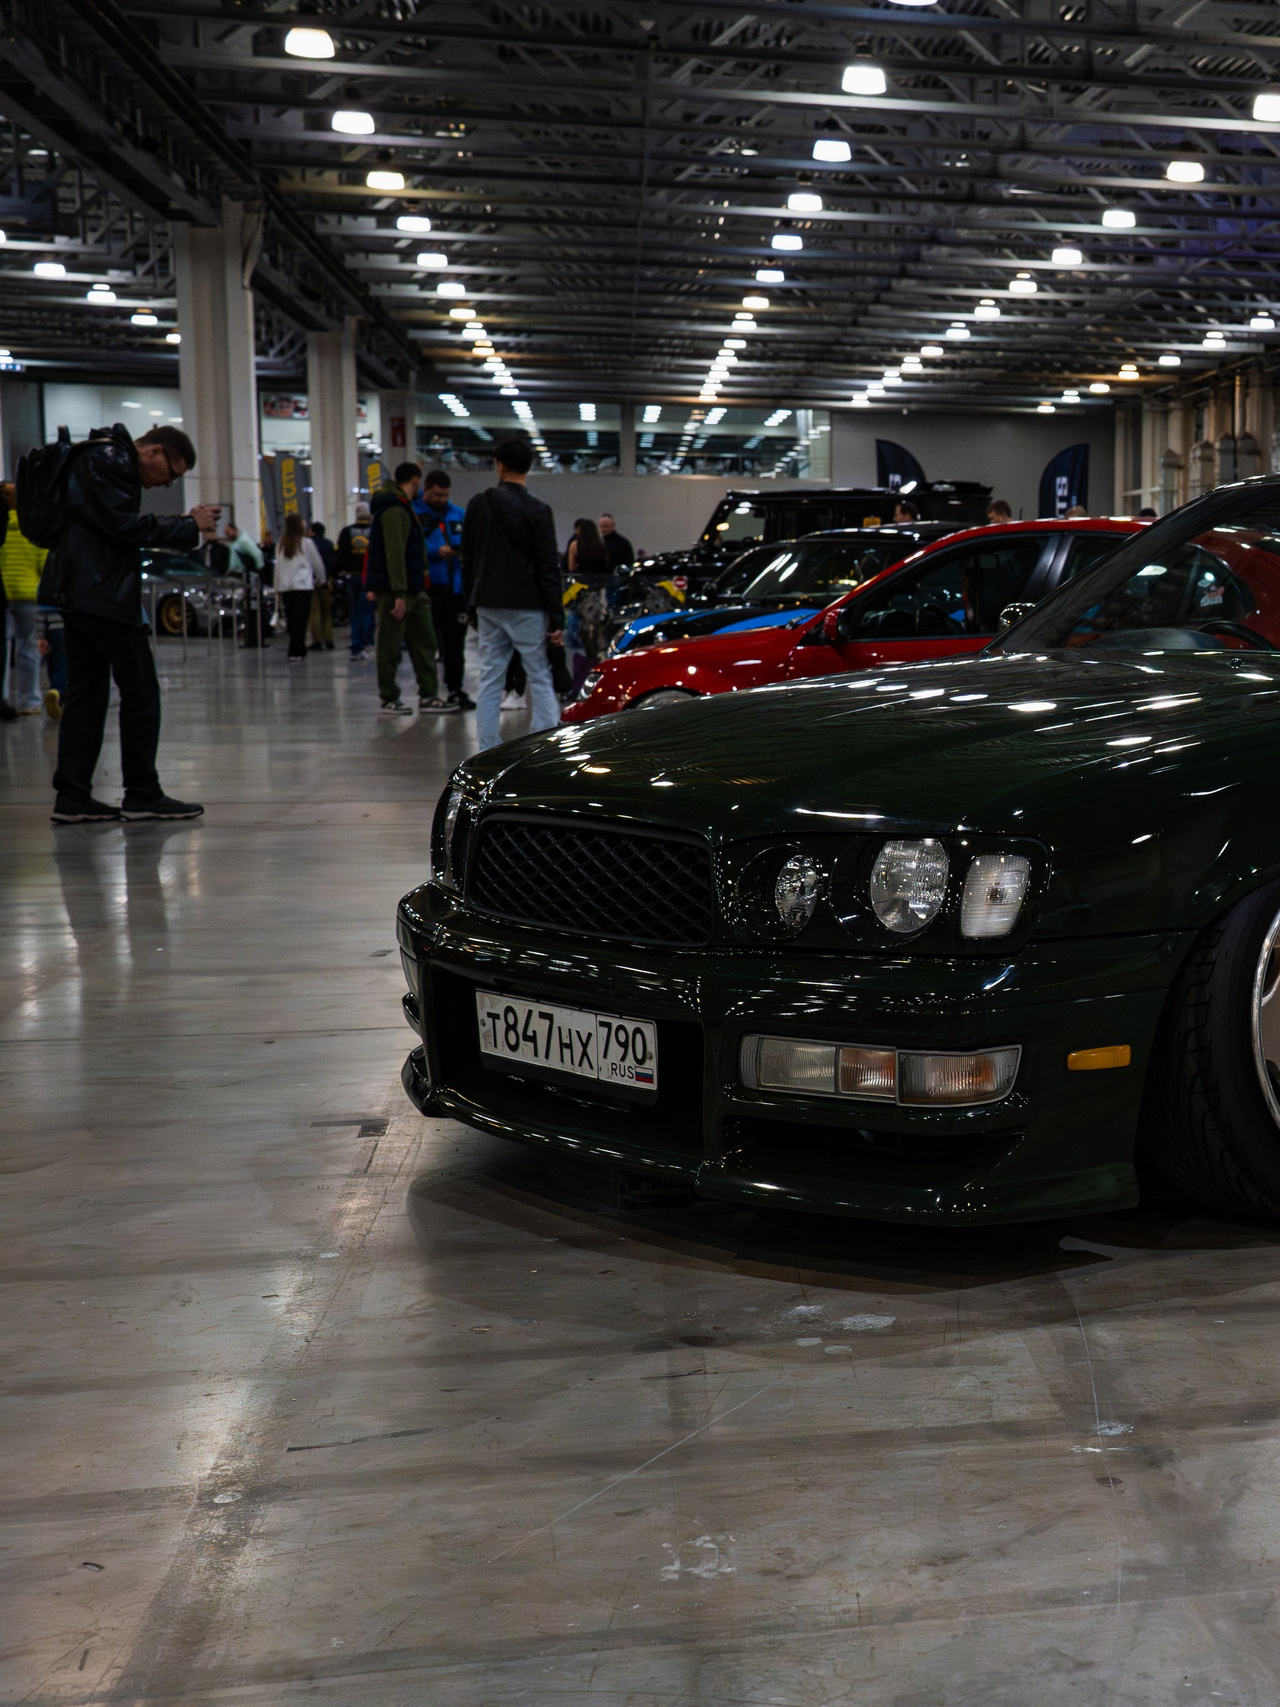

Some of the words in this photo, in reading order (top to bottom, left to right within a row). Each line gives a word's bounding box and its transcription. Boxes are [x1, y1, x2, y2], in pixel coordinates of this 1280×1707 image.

[486, 1004, 595, 1071] T847HX
[598, 1020, 648, 1066] 790
[610, 1062, 634, 1080] RUS
